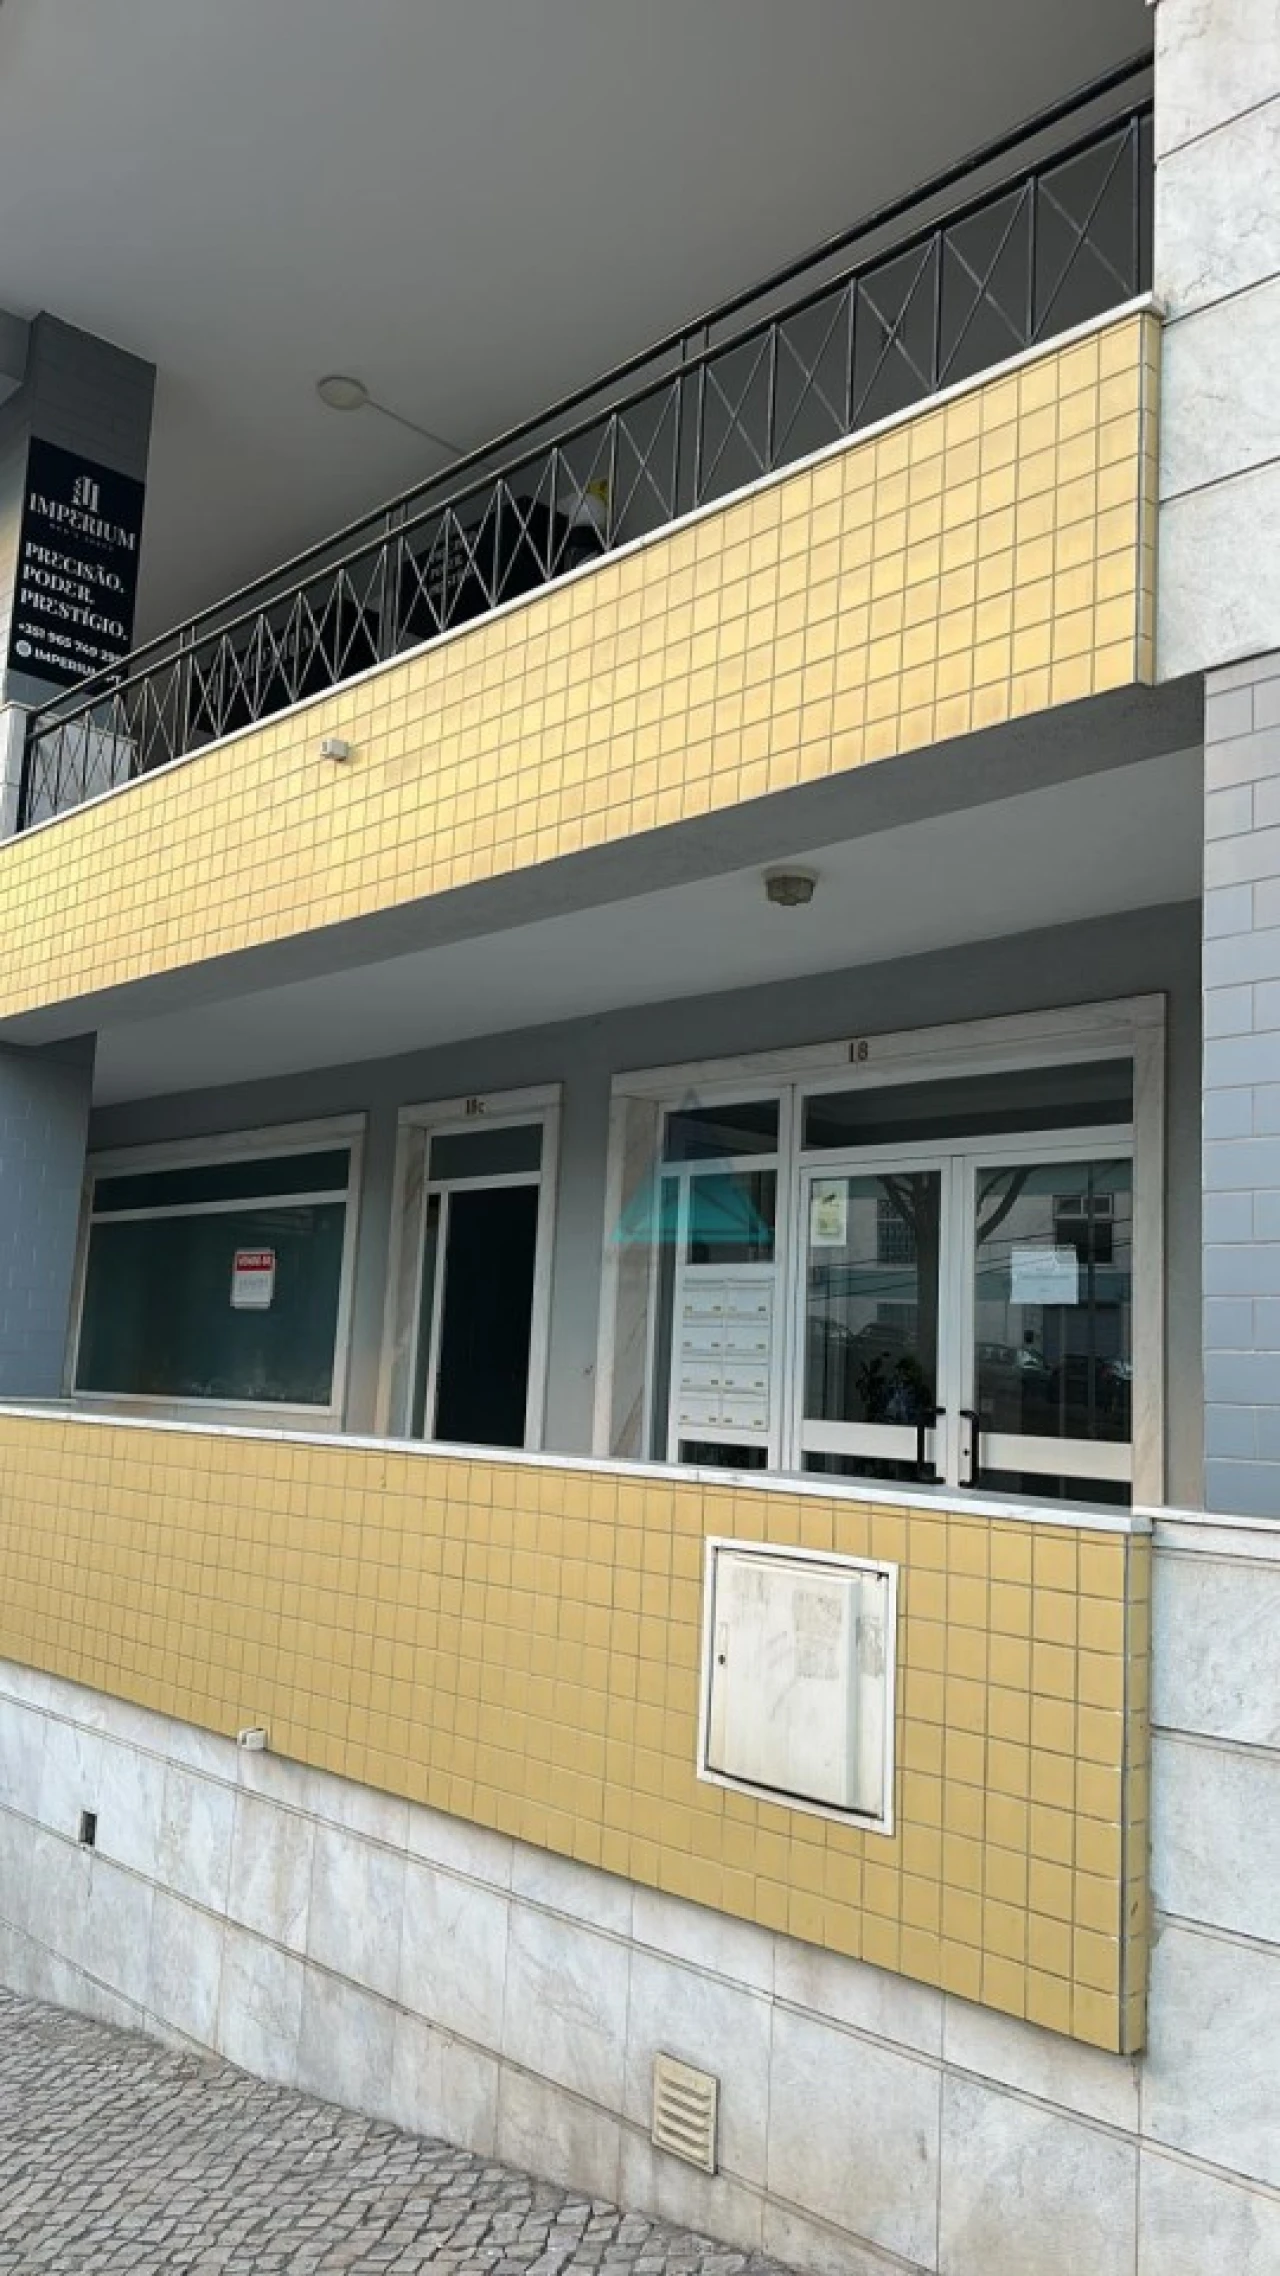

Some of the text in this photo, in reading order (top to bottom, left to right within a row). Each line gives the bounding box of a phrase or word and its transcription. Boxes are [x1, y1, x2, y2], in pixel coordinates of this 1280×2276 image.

[28, 492, 136, 551] IMPERIUM
[23, 563, 96, 606] PODER.
[25, 541, 126, 595] PRECISÃO.
[20, 587, 129, 642] PRESTÍGIO.
[848, 1040, 868, 1063] 18
